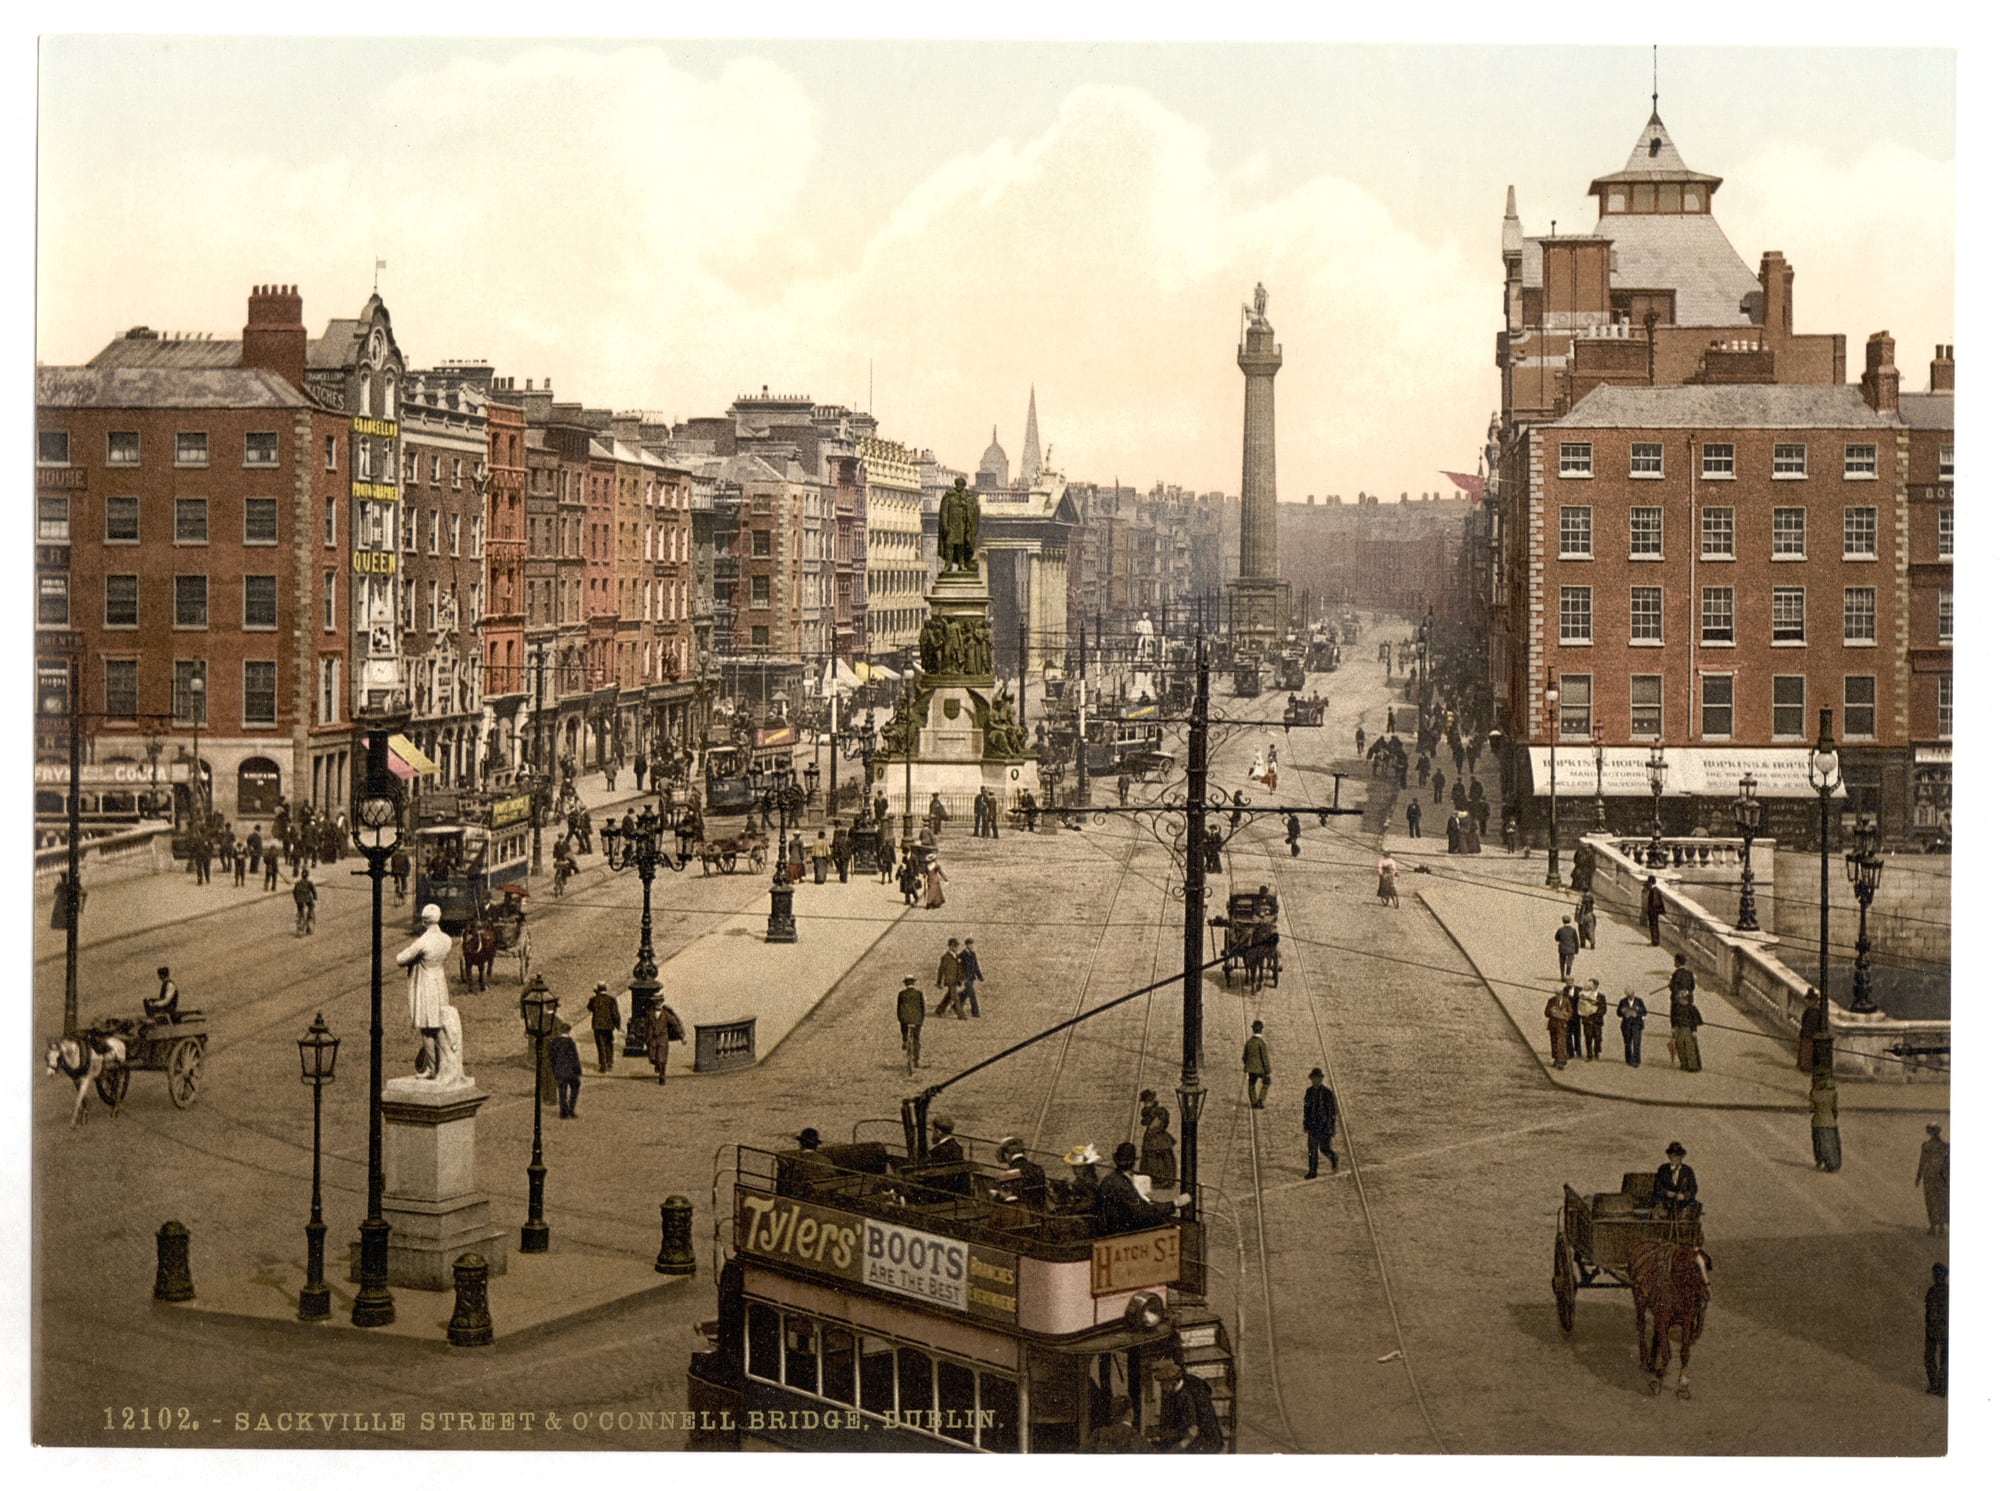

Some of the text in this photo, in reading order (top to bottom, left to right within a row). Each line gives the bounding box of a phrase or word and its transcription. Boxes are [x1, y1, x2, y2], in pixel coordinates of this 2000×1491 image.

[353, 550, 396, 575] QUEEN
[1703, 760, 1759, 768] HOPKINS
[743, 1196, 963, 1281] Tylers' BOOTS
[870, 1262, 895, 1285] ARE
[900, 1269, 924, 1293] THE
[929, 1277, 961, 1301] BEST
[1094, 1244, 1149, 1290] HATCH
